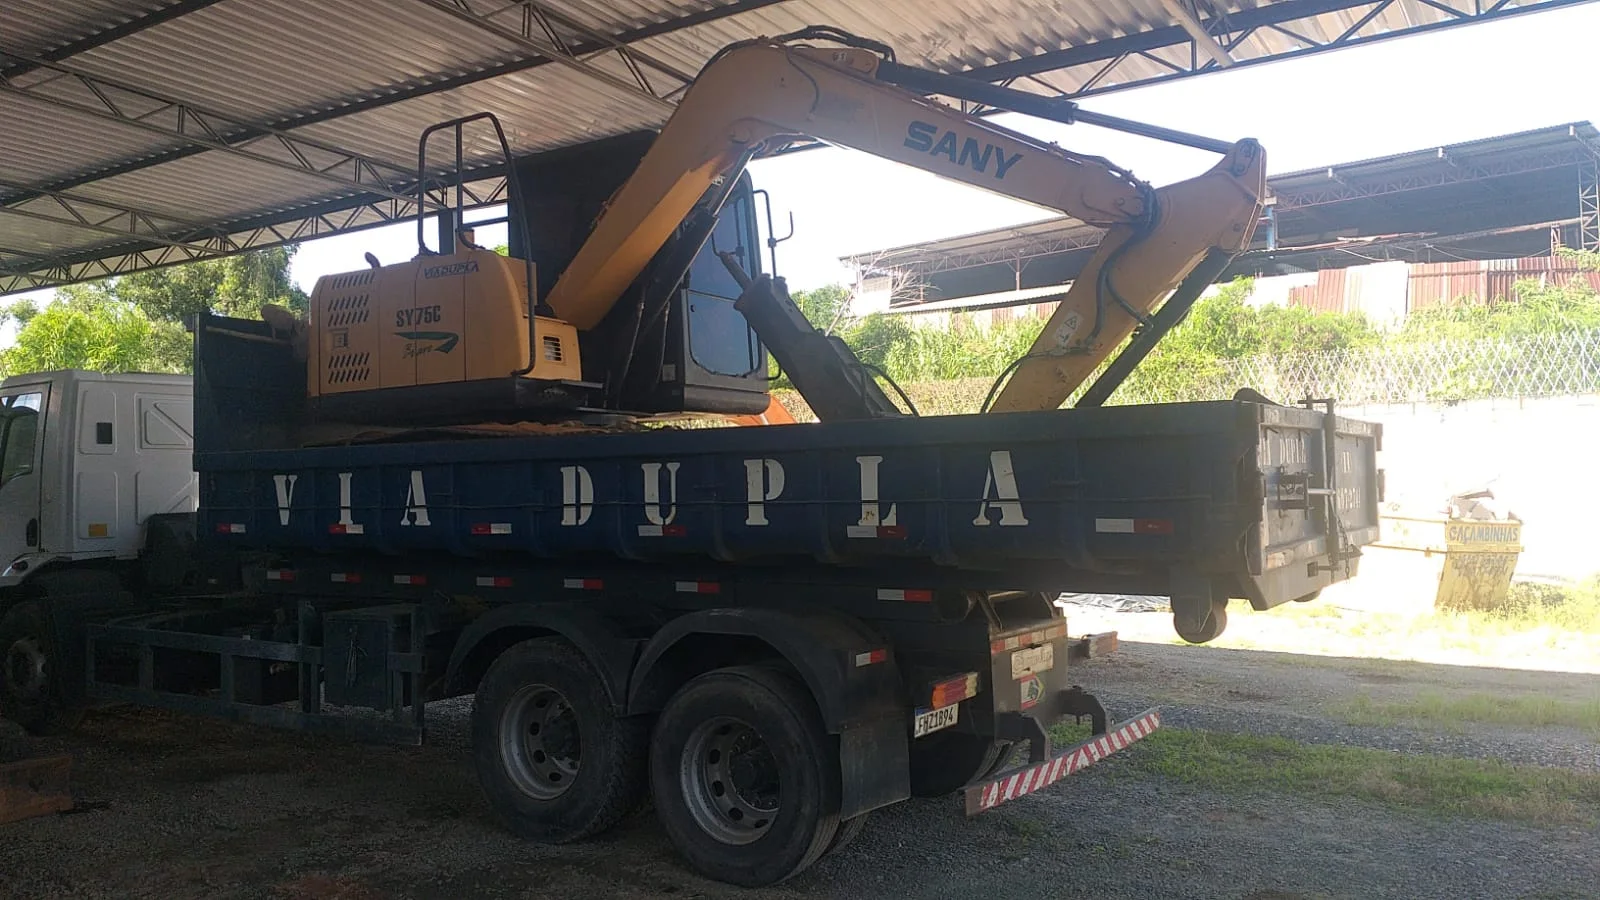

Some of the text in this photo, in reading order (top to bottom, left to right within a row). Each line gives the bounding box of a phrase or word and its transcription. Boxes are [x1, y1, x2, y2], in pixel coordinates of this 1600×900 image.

[904, 120, 1023, 179] SANY
[396, 306, 441, 327] SY75C
[273, 450, 1029, 527] VIA DUPLA
[918, 707, 954, 733] FHZ1B94
